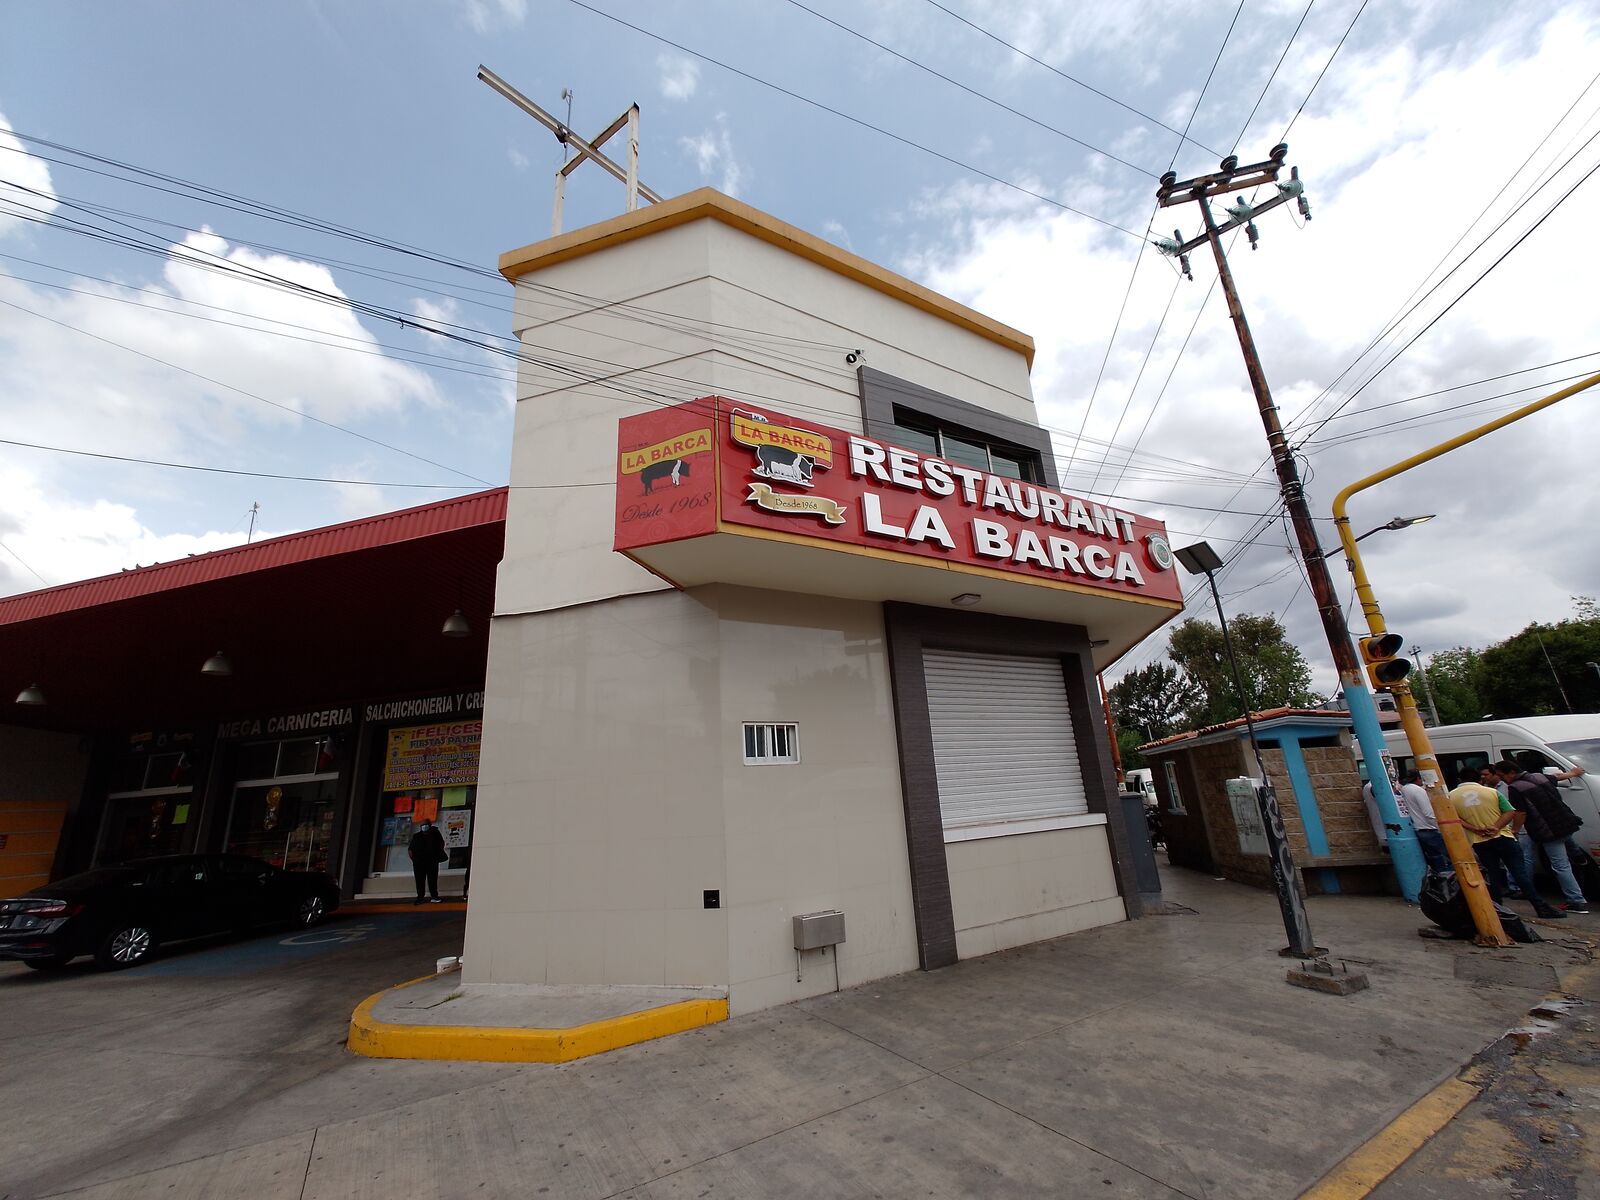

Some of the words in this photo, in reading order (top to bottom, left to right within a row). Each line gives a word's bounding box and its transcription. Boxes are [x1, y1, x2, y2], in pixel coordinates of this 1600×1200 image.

[626, 454, 646, 469] LA
[651, 434, 707, 461] BARCA
[740, 423, 763, 440] LA
[768, 428, 827, 454] BARCA
[775, 499, 801, 508] Desde
[802, 501, 818, 510] 1968
[849, 436, 1136, 543] RESTAURANT
[621, 502, 663, 523] Desde
[670, 491, 712, 513] 1968
[862, 492, 956, 549] LA
[972, 517, 1146, 586] BARCA
[366, 695, 453, 722] SALCHICHONERIA
[456, 693, 464, 711] Y
[217, 719, 261, 738] MEGA
[267, 708, 352, 733] CARNICERIA
[410, 738, 445, 748] FIESTAS
[1462, 790, 1480, 807] 2
